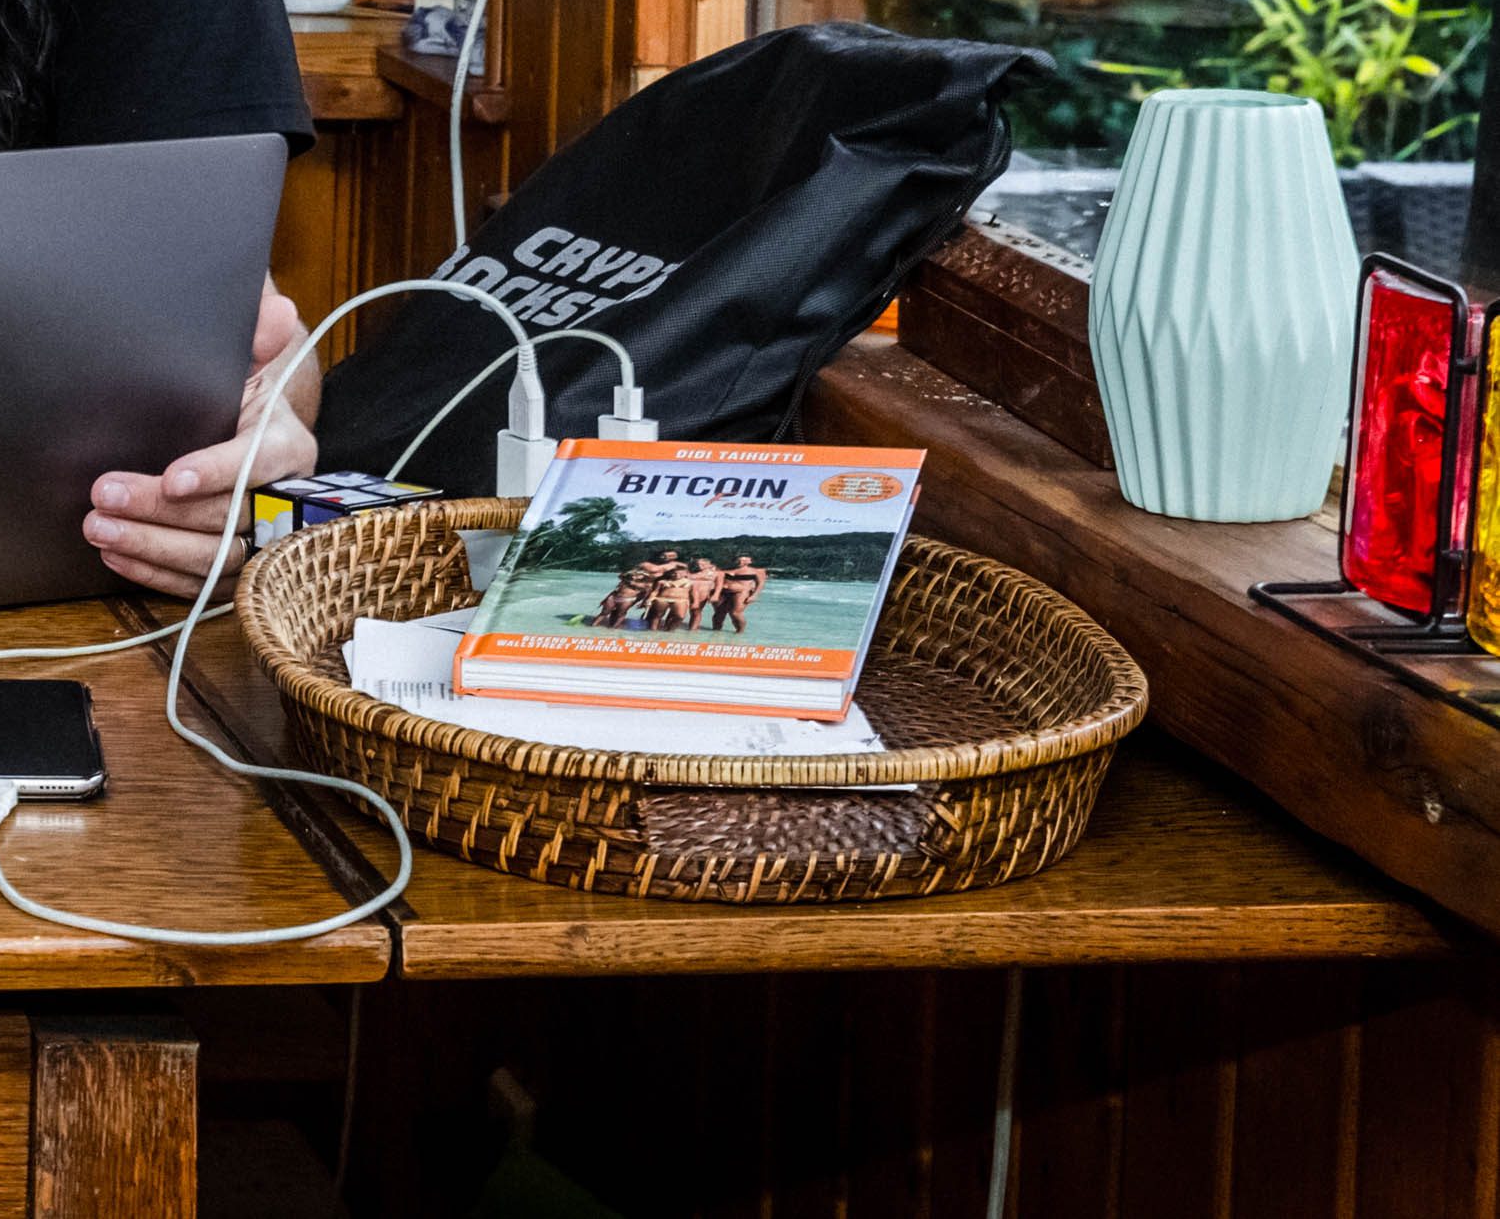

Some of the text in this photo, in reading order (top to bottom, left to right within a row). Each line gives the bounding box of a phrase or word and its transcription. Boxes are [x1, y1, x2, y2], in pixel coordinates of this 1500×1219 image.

[676, 449, 805, 462] DIDI TAIHUTTU
[617, 473, 789, 499] BITCOIN
[703, 491, 810, 517] Family
